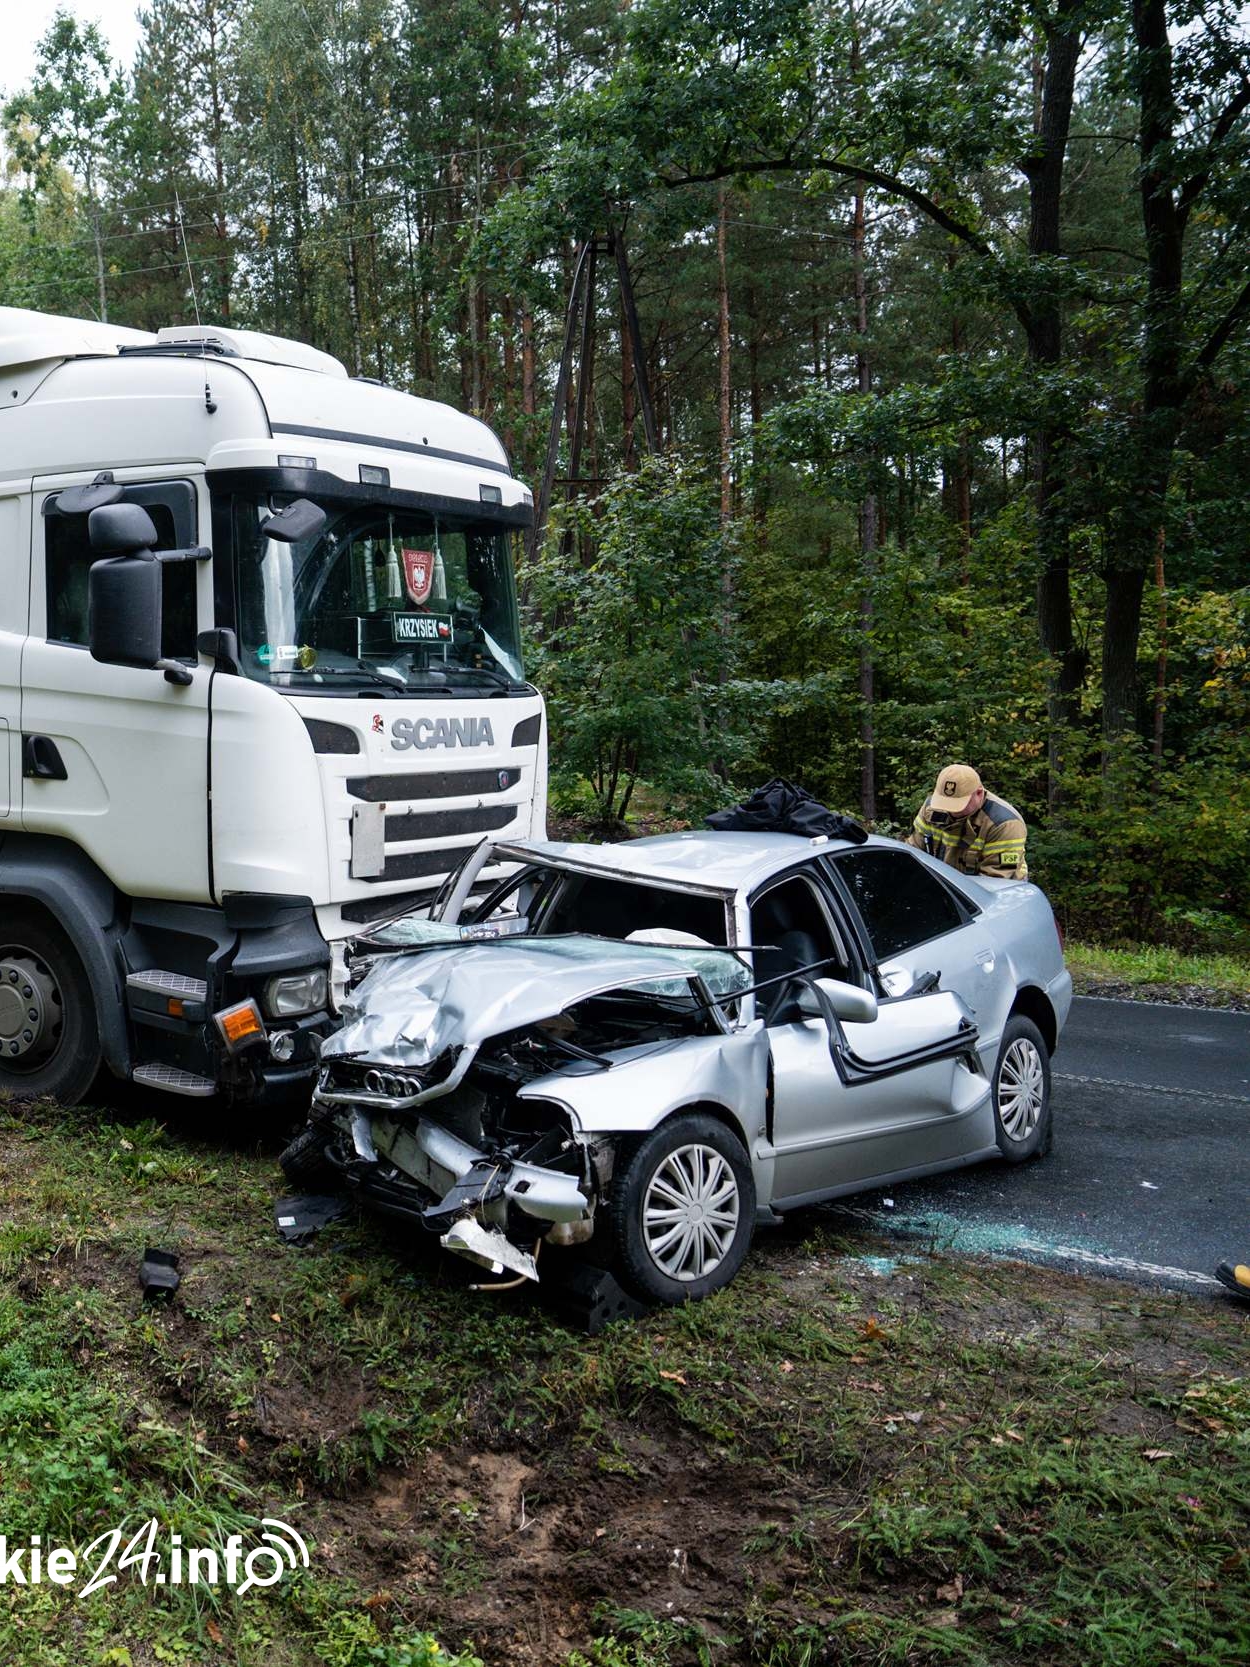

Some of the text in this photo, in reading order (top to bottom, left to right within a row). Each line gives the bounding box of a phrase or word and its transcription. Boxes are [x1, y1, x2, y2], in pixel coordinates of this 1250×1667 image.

[398, 618, 439, 638] KRZYSIEK
[390, 717, 494, 751] SCANIA
[1003, 854, 1018, 863] PSP
